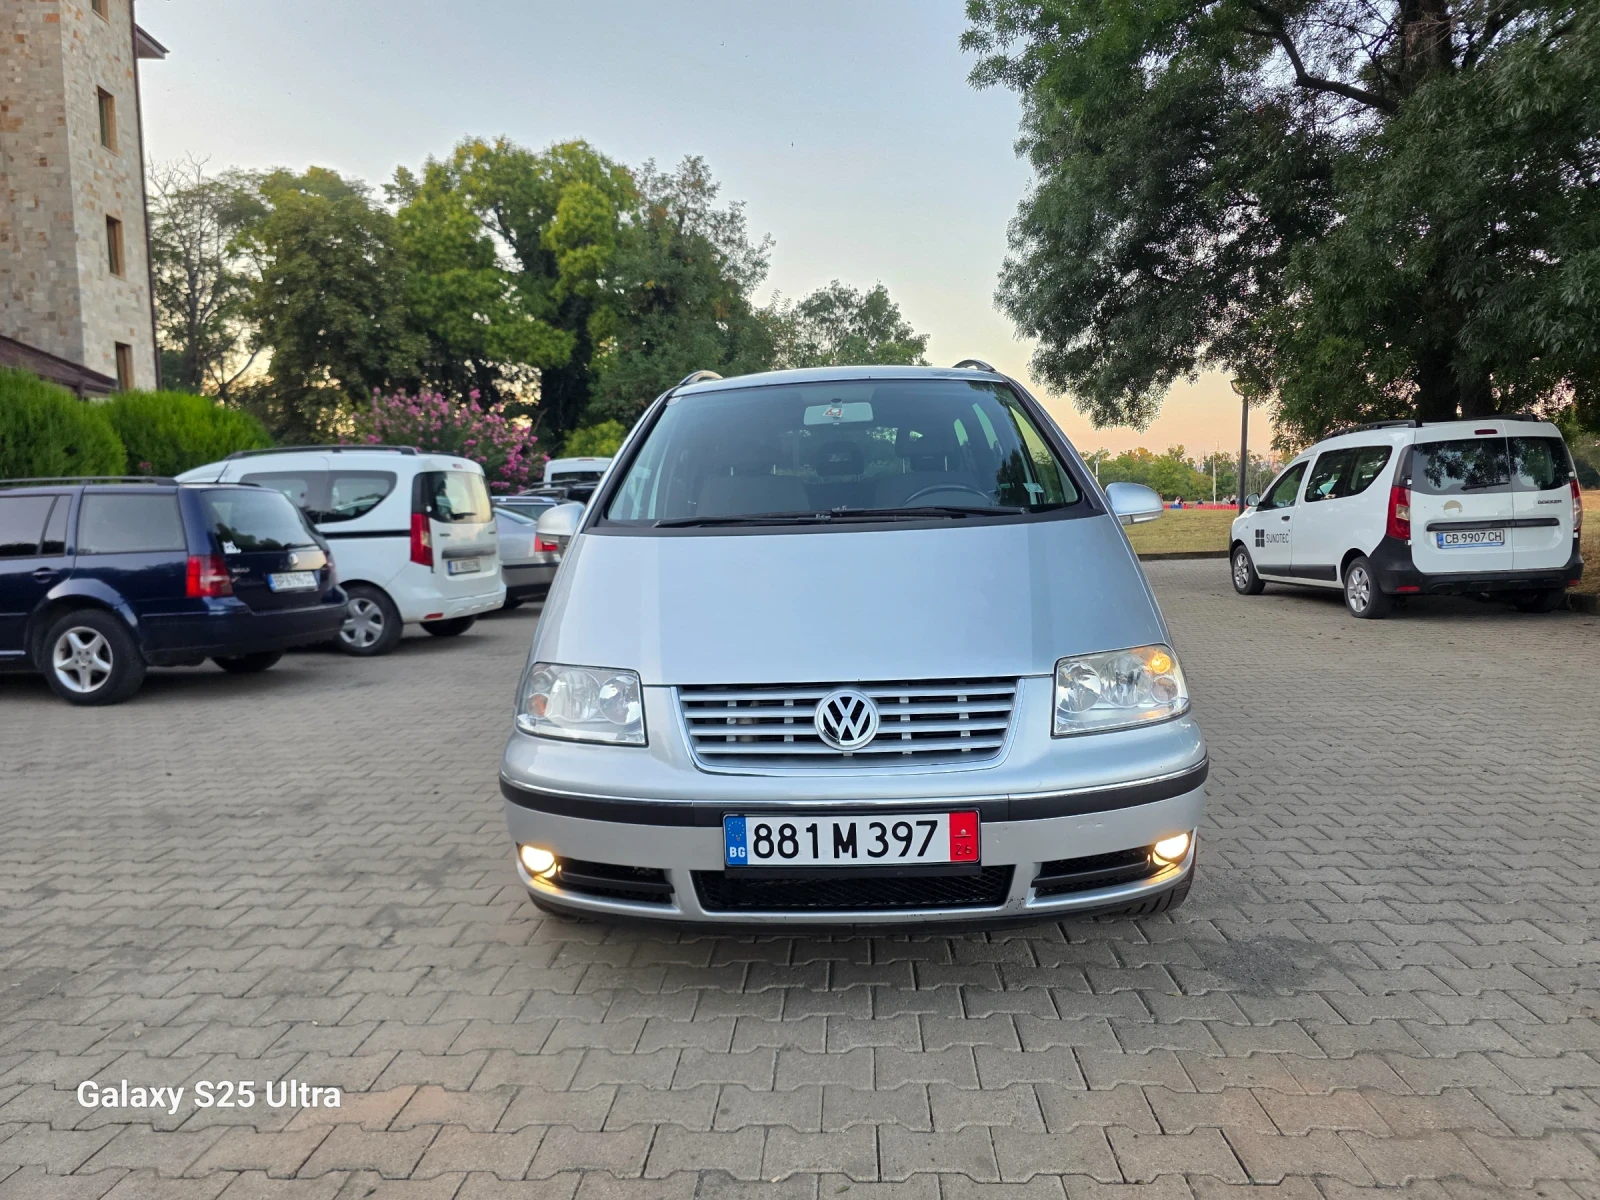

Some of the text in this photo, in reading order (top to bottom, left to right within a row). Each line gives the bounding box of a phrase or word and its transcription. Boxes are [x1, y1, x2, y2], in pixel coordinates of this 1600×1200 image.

[1266, 533, 1289, 543] SUNOTEC
[1445, 531, 1502, 544] CB 9907 CH
[729, 820, 938, 859] BG 881 M 397
[955, 843, 972, 856] 26
